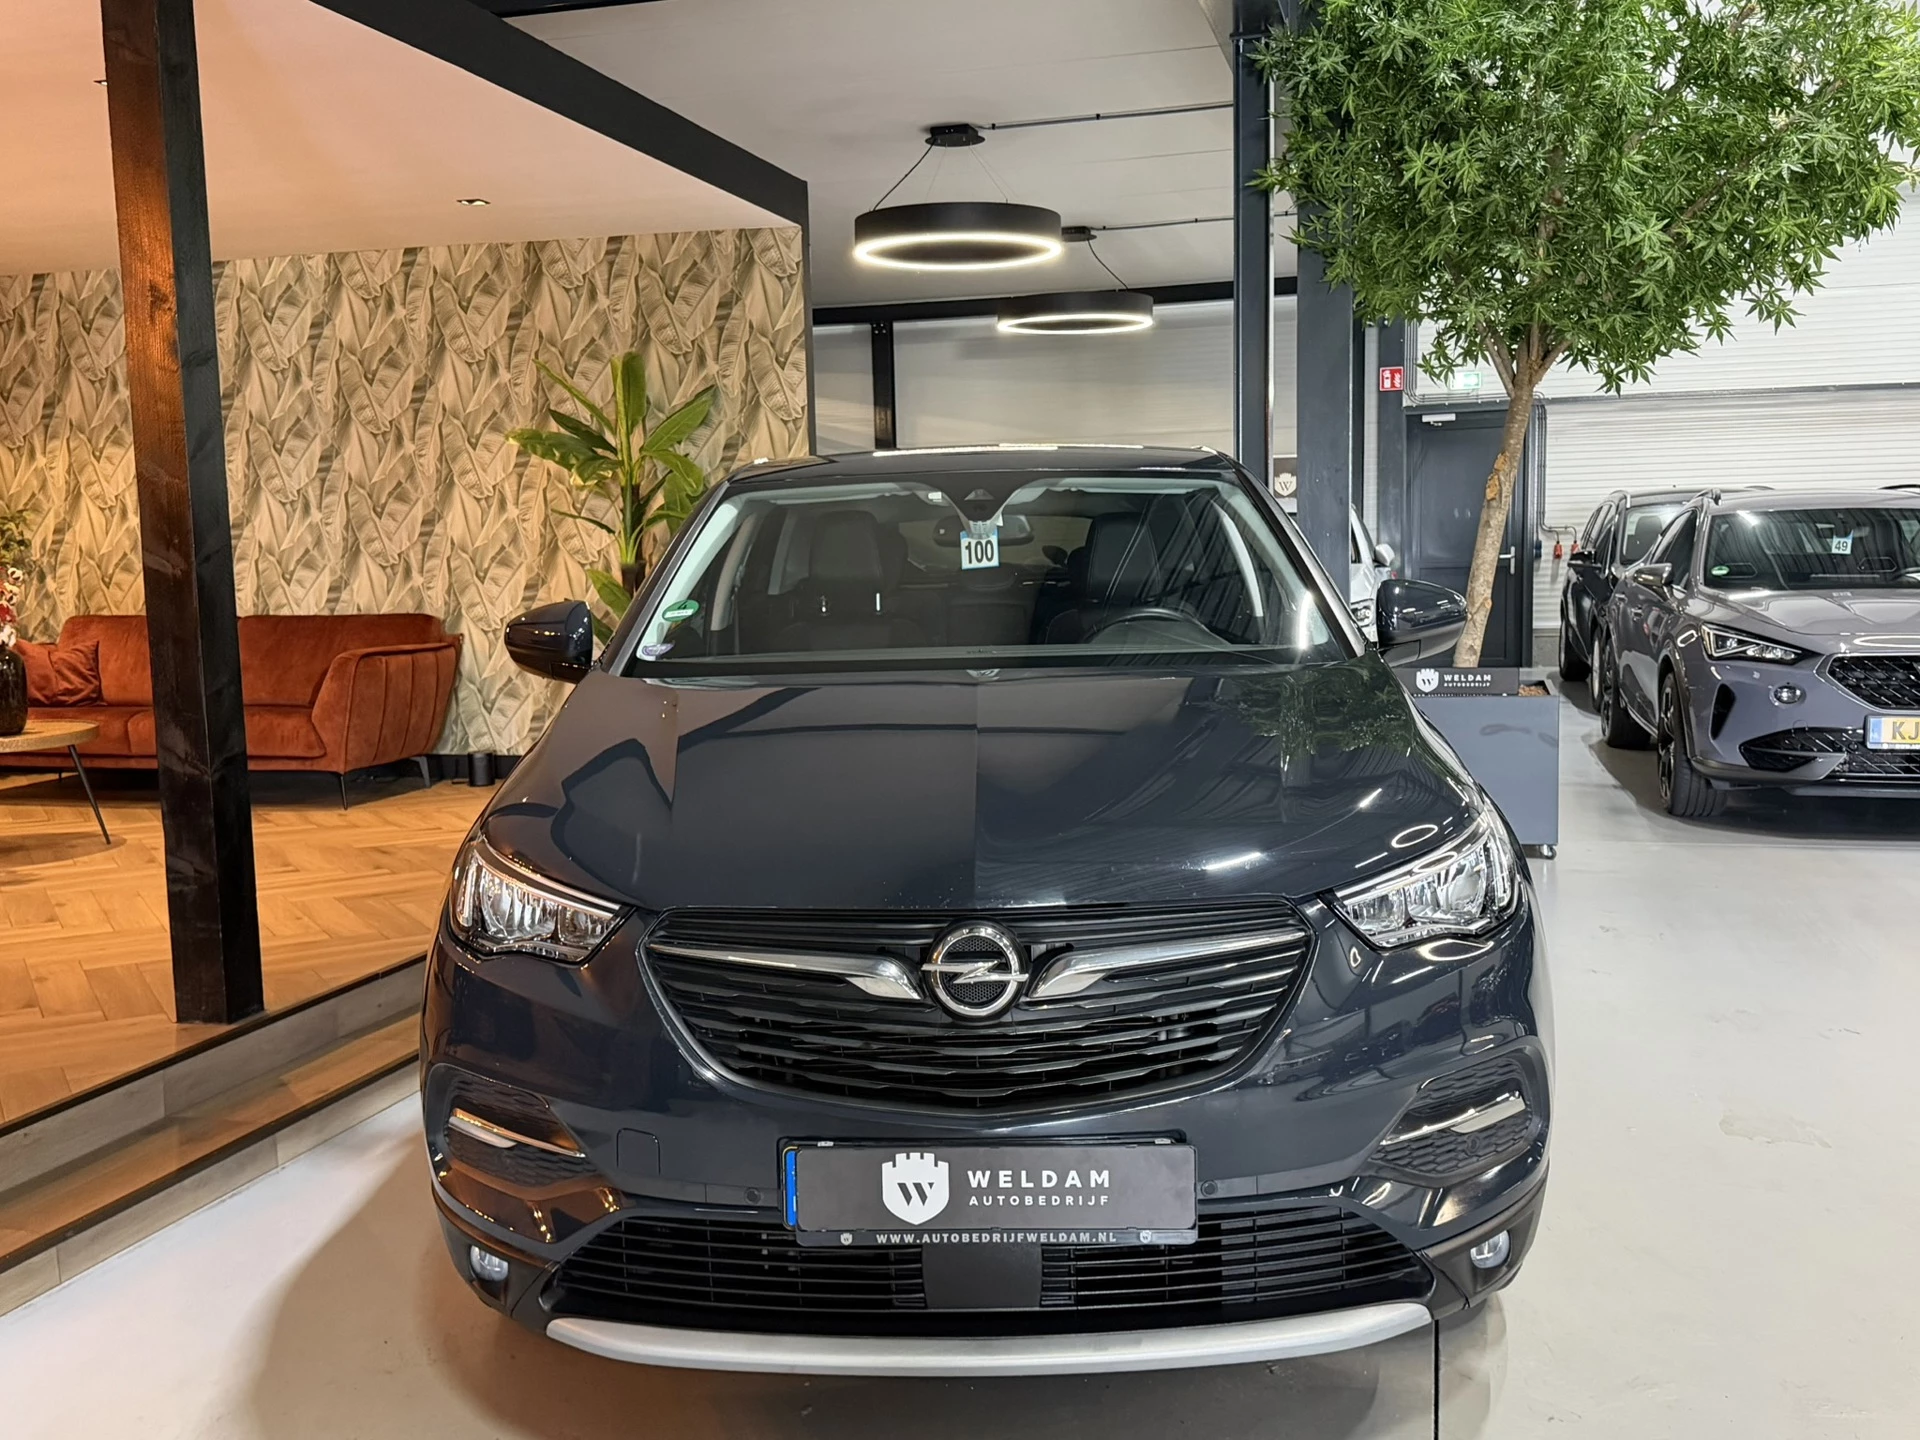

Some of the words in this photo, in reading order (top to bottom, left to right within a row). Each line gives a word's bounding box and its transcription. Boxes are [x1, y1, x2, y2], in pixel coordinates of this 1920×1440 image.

[964, 539, 994, 565] 100
[1834, 540, 1849, 552] 49
[1443, 674, 1492, 682] WELDAM
[967, 1169, 1111, 1188] WELDAM
[896, 1182, 935, 1207] W
[969, 1195, 1110, 1206] AUTOBEDRIJF
[876, 1232, 1117, 1244] WWW.AUTOBEDRIJFWELDAM.NL
